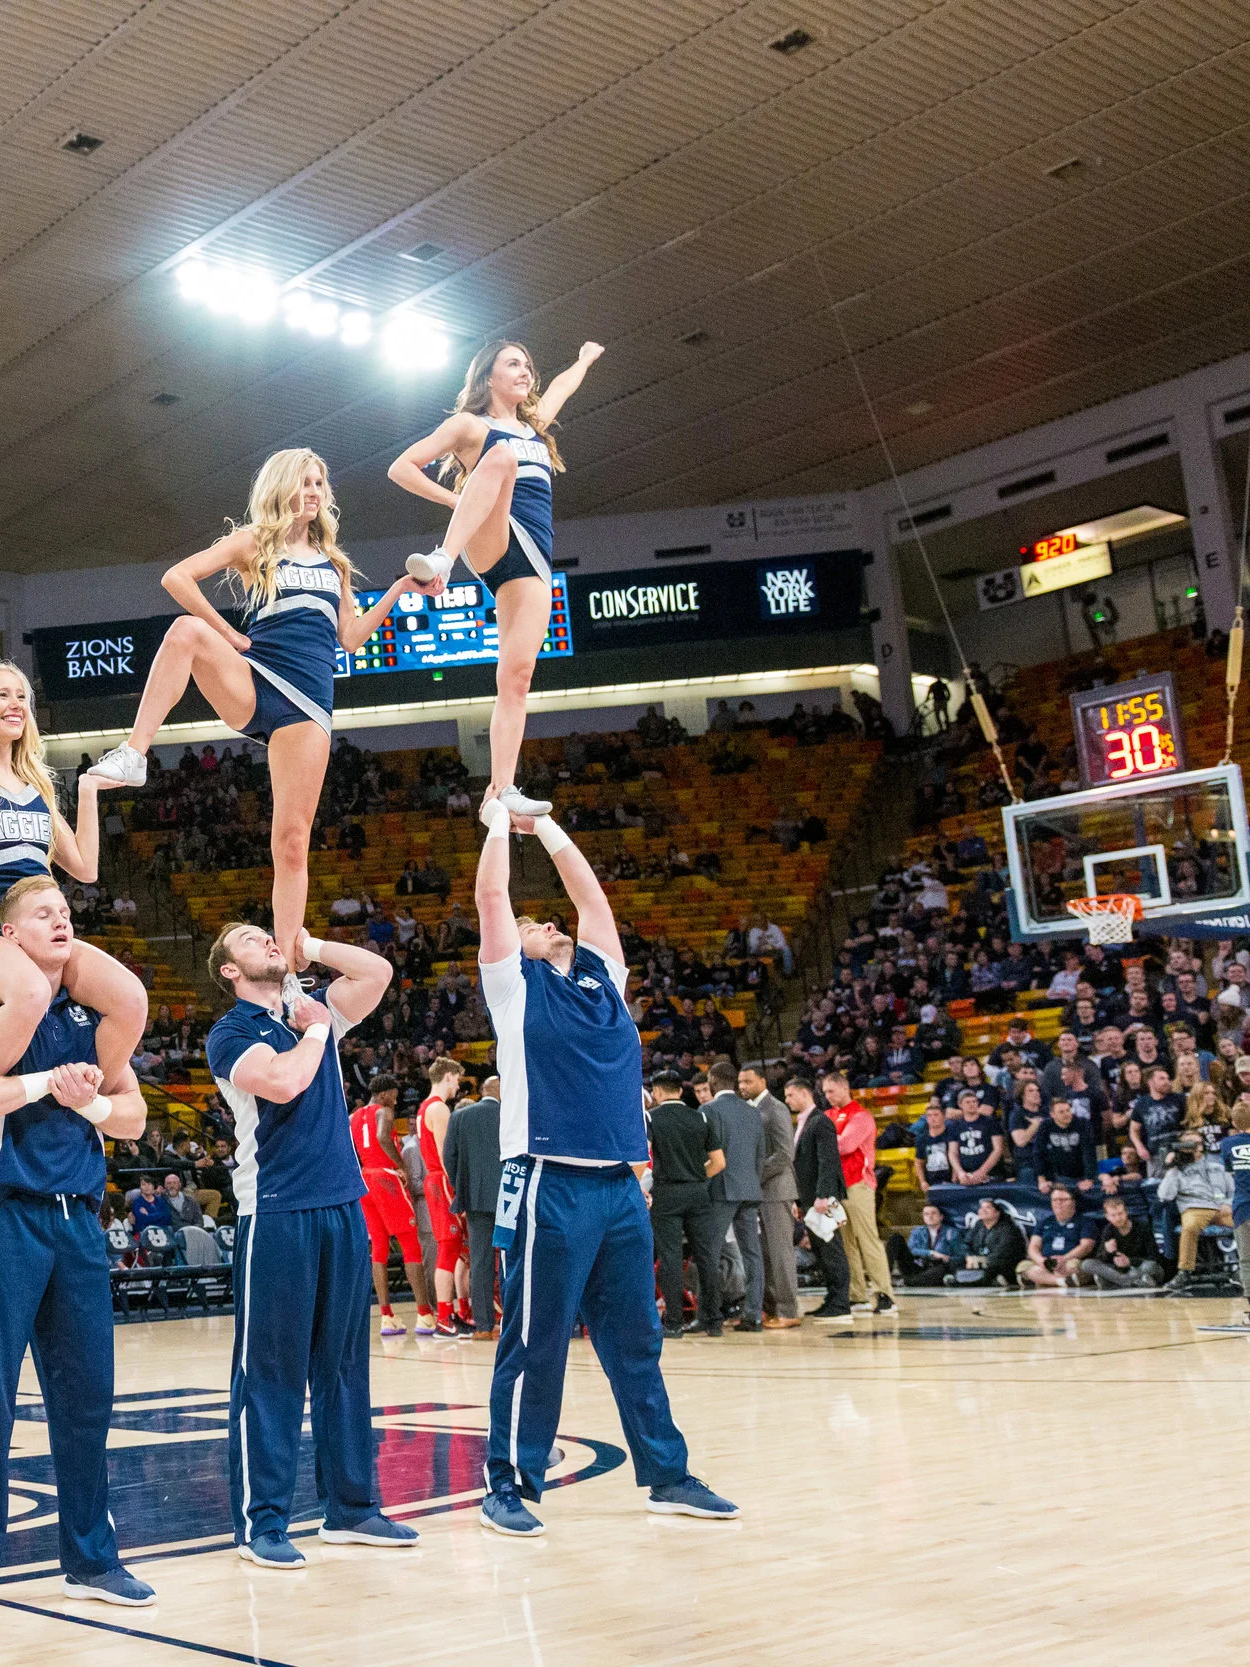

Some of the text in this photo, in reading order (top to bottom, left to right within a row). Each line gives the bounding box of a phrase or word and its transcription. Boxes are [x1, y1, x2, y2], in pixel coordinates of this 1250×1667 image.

[1034, 534, 1077, 562] 920
[766, 568, 808, 588] NEW
[589, 582, 700, 620] CONSERVICE
[761, 580, 815, 602] YORK
[770, 599, 812, 615] LIFE
[66, 636, 135, 659] ZIONS
[67, 659, 135, 679] BANK
[1100, 693, 1164, 730] 11:55
[1104, 724, 1164, 779] 30
[362, 1122, 370, 1149] 1
